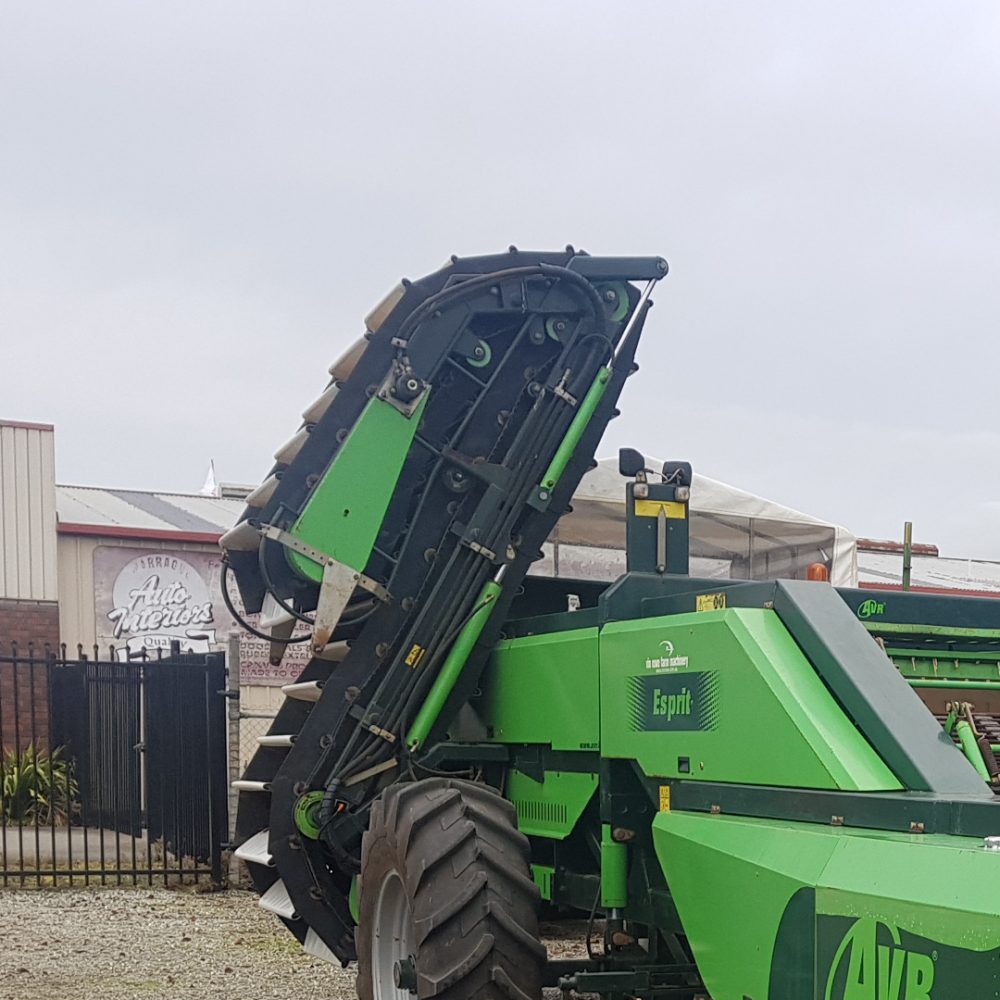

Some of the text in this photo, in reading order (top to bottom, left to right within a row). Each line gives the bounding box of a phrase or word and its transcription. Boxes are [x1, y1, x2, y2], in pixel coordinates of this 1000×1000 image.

[129, 575, 192, 611] Auto
[858, 600, 884, 618] AVR
[107, 602, 214, 640] Interiors
[144, 637, 187, 649] Qualy
[653, 687, 690, 721] Esprit
